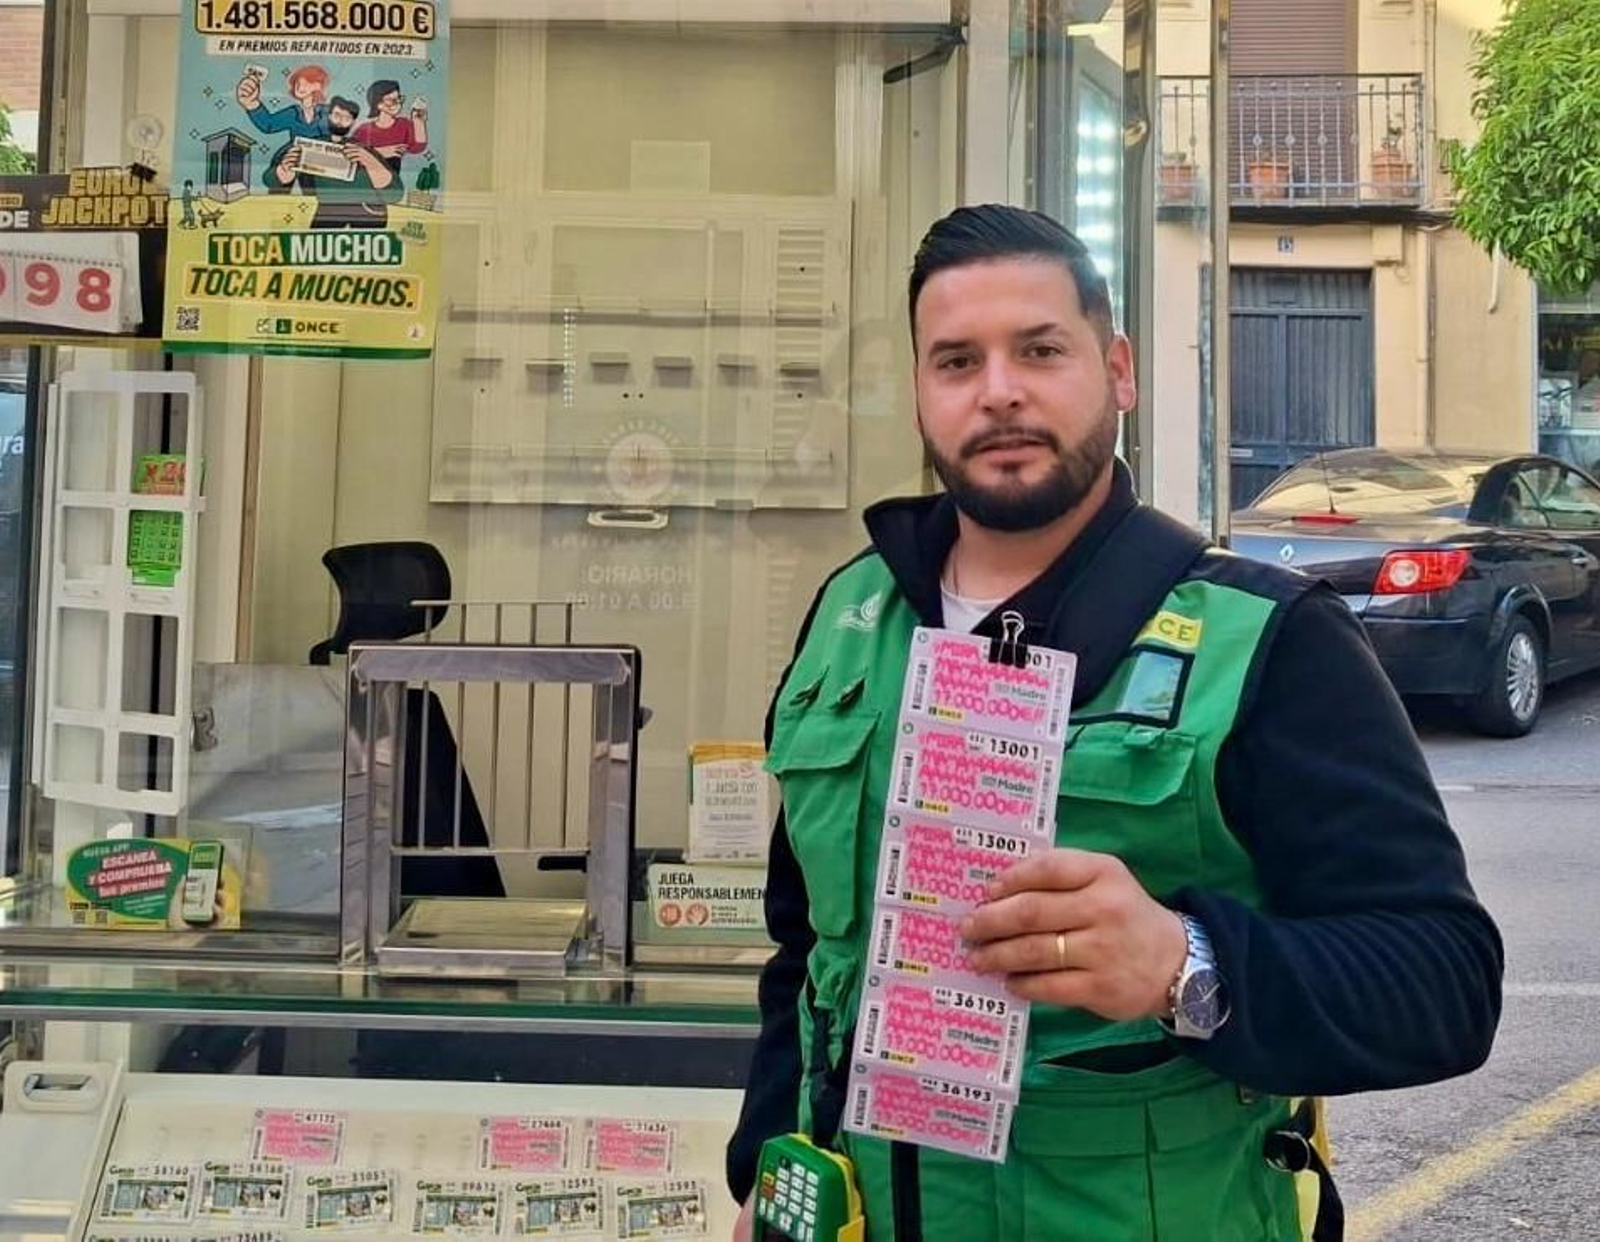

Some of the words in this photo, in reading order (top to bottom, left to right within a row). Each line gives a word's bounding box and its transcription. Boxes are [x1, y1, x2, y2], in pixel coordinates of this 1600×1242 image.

[200, 1, 404, 30] 1.481.568.000
[413, 7, 429, 33] €
[219, 40, 234, 50] EN
[237, 40, 287, 51] PREMIOS
[290, 41, 361, 53] REPARTIDOS
[365, 43, 379, 54] EN
[382, 44, 415, 55] 2023.
[41, 195, 168, 227] JACKPOT
[212, 234, 284, 264] TOCA
[290, 234, 399, 263] MUCHO.
[0, 256, 112, 312] 98
[190, 267, 256, 298] TOCA
[263, 270, 282, 300] A
[288, 274, 414, 308] MUCHOS.
[295, 321, 339, 334] ONCE
[990, 738, 1039, 761] 13001
[997, 779, 1035, 794] Madre
[976, 831, 1028, 855] 13001
[102, 851, 158, 869] ESCANEA
[99, 861, 173, 885] COMPRUEBA
[658, 872, 694, 885] JUEGA
[954, 992, 1007, 1015] 36193
[941, 1081, 992, 1103] 36193
